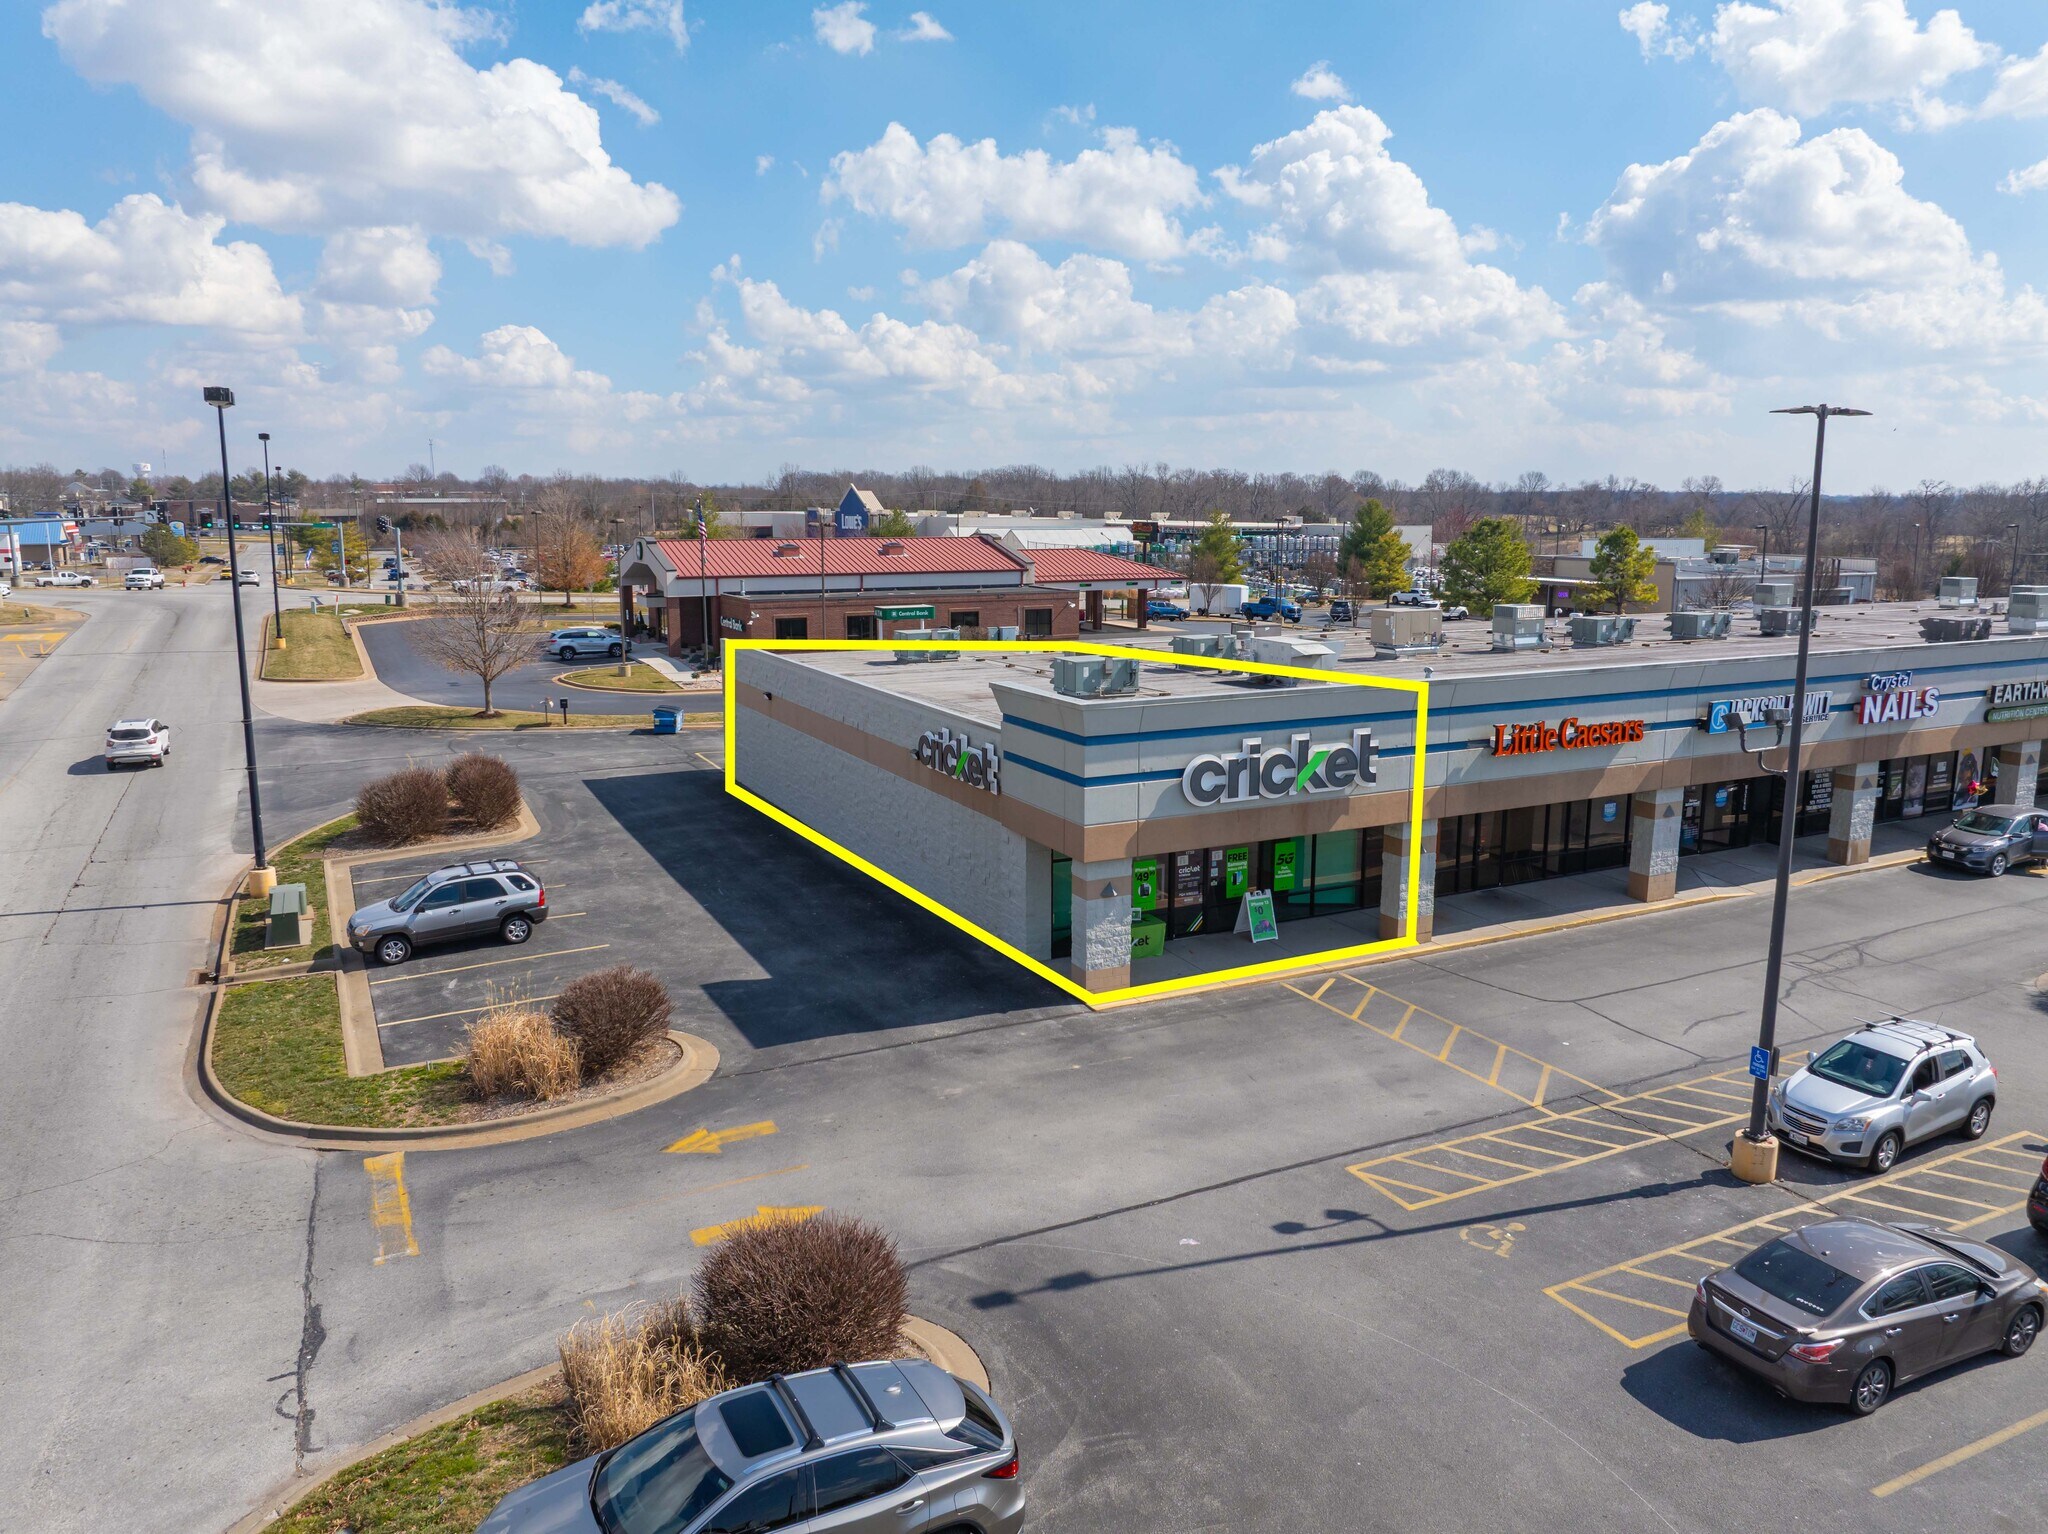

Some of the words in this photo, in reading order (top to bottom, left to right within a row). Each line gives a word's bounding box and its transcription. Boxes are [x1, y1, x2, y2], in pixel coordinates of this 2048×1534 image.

[1871, 671, 1913, 692] Crystal
[1788, 690, 1833, 720] HWITT
[1861, 687, 1940, 724] NAILS
[1992, 708, 2024, 720] NUTRITION
[2025, 705, 2048, 717] CENTER
[1493, 720, 1557, 757] Little
[1558, 717, 1645, 750] Caesars
[918, 728, 996, 795] cricket
[1184, 729, 1379, 805] cricket
[1227, 851, 1247, 862] FREE
[1275, 852, 1295, 865] 5G
